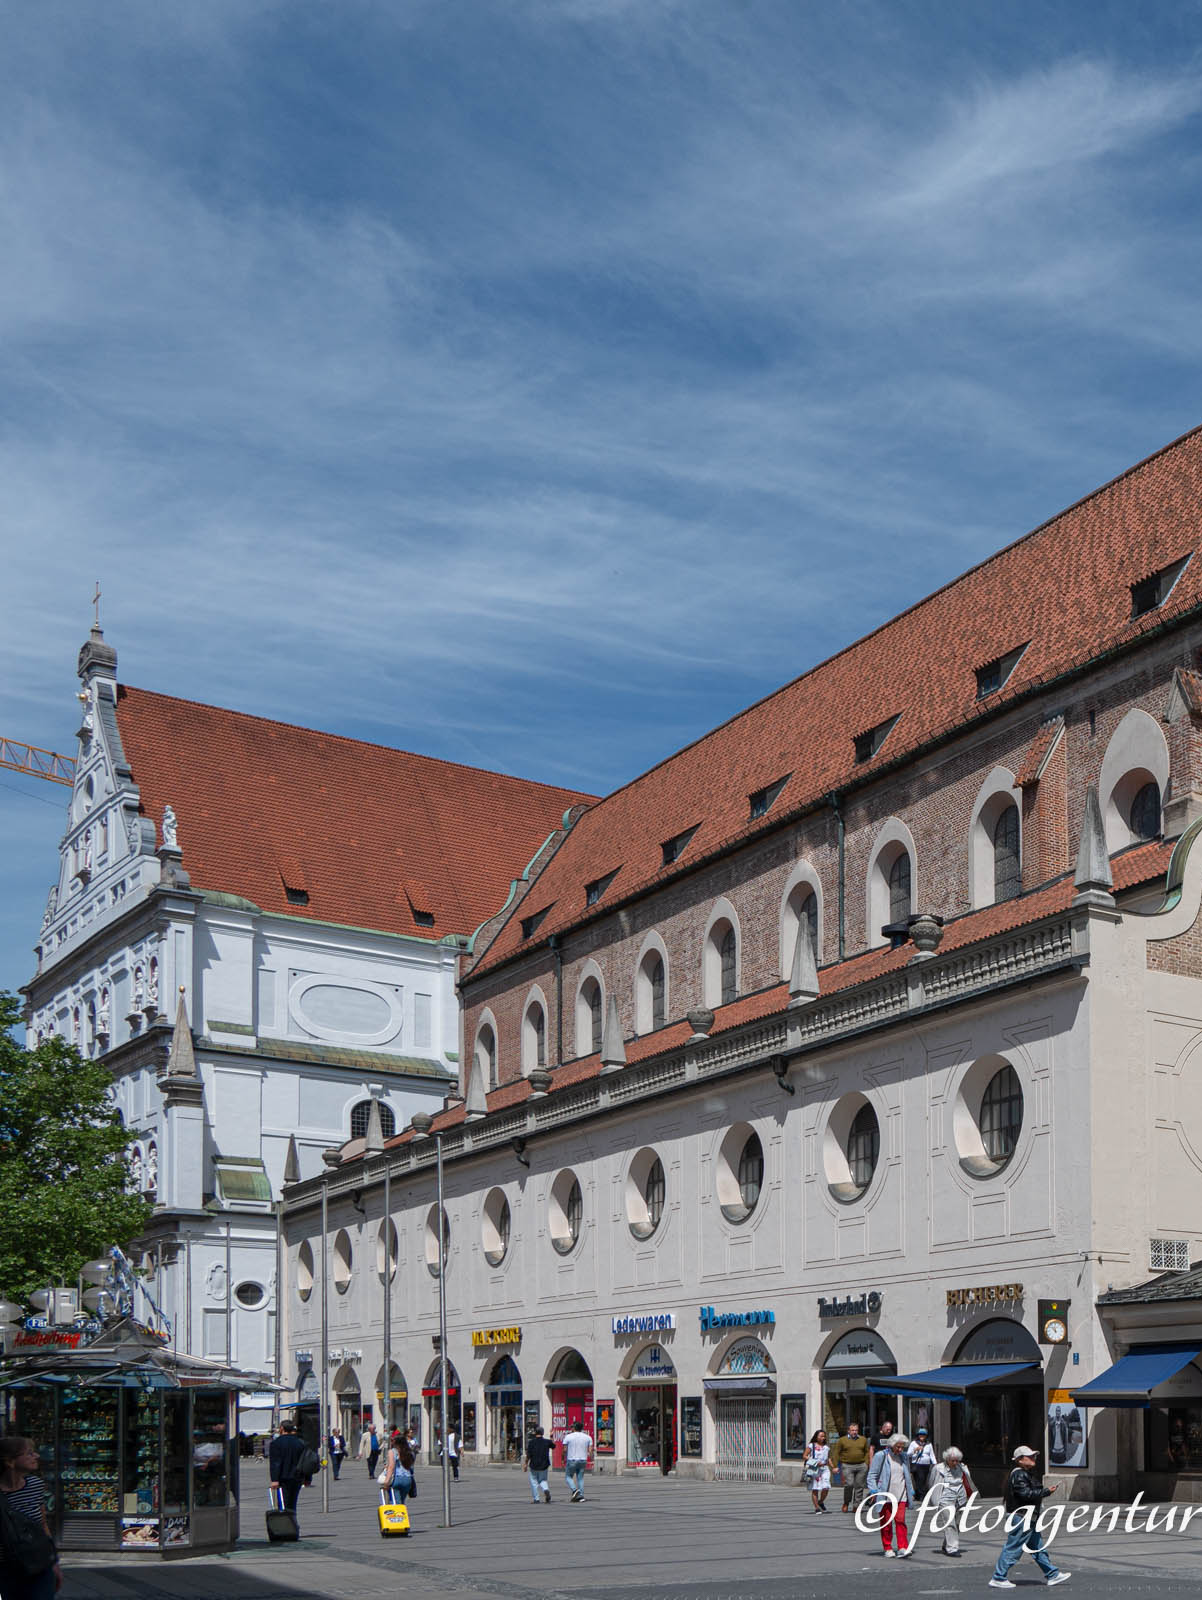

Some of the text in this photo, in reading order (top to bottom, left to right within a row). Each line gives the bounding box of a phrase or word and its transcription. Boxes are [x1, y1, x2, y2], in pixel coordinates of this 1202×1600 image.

[946, 1284, 1024, 1305] BUCHERER
[817, 1293, 867, 1318] Timberland
[611, 1313, 674, 1334] Lederwaren
[472, 1326, 521, 1346] MAX KRUG
[553, 1402, 565, 1415] WIR
[553, 1416, 567, 1428] SIND
